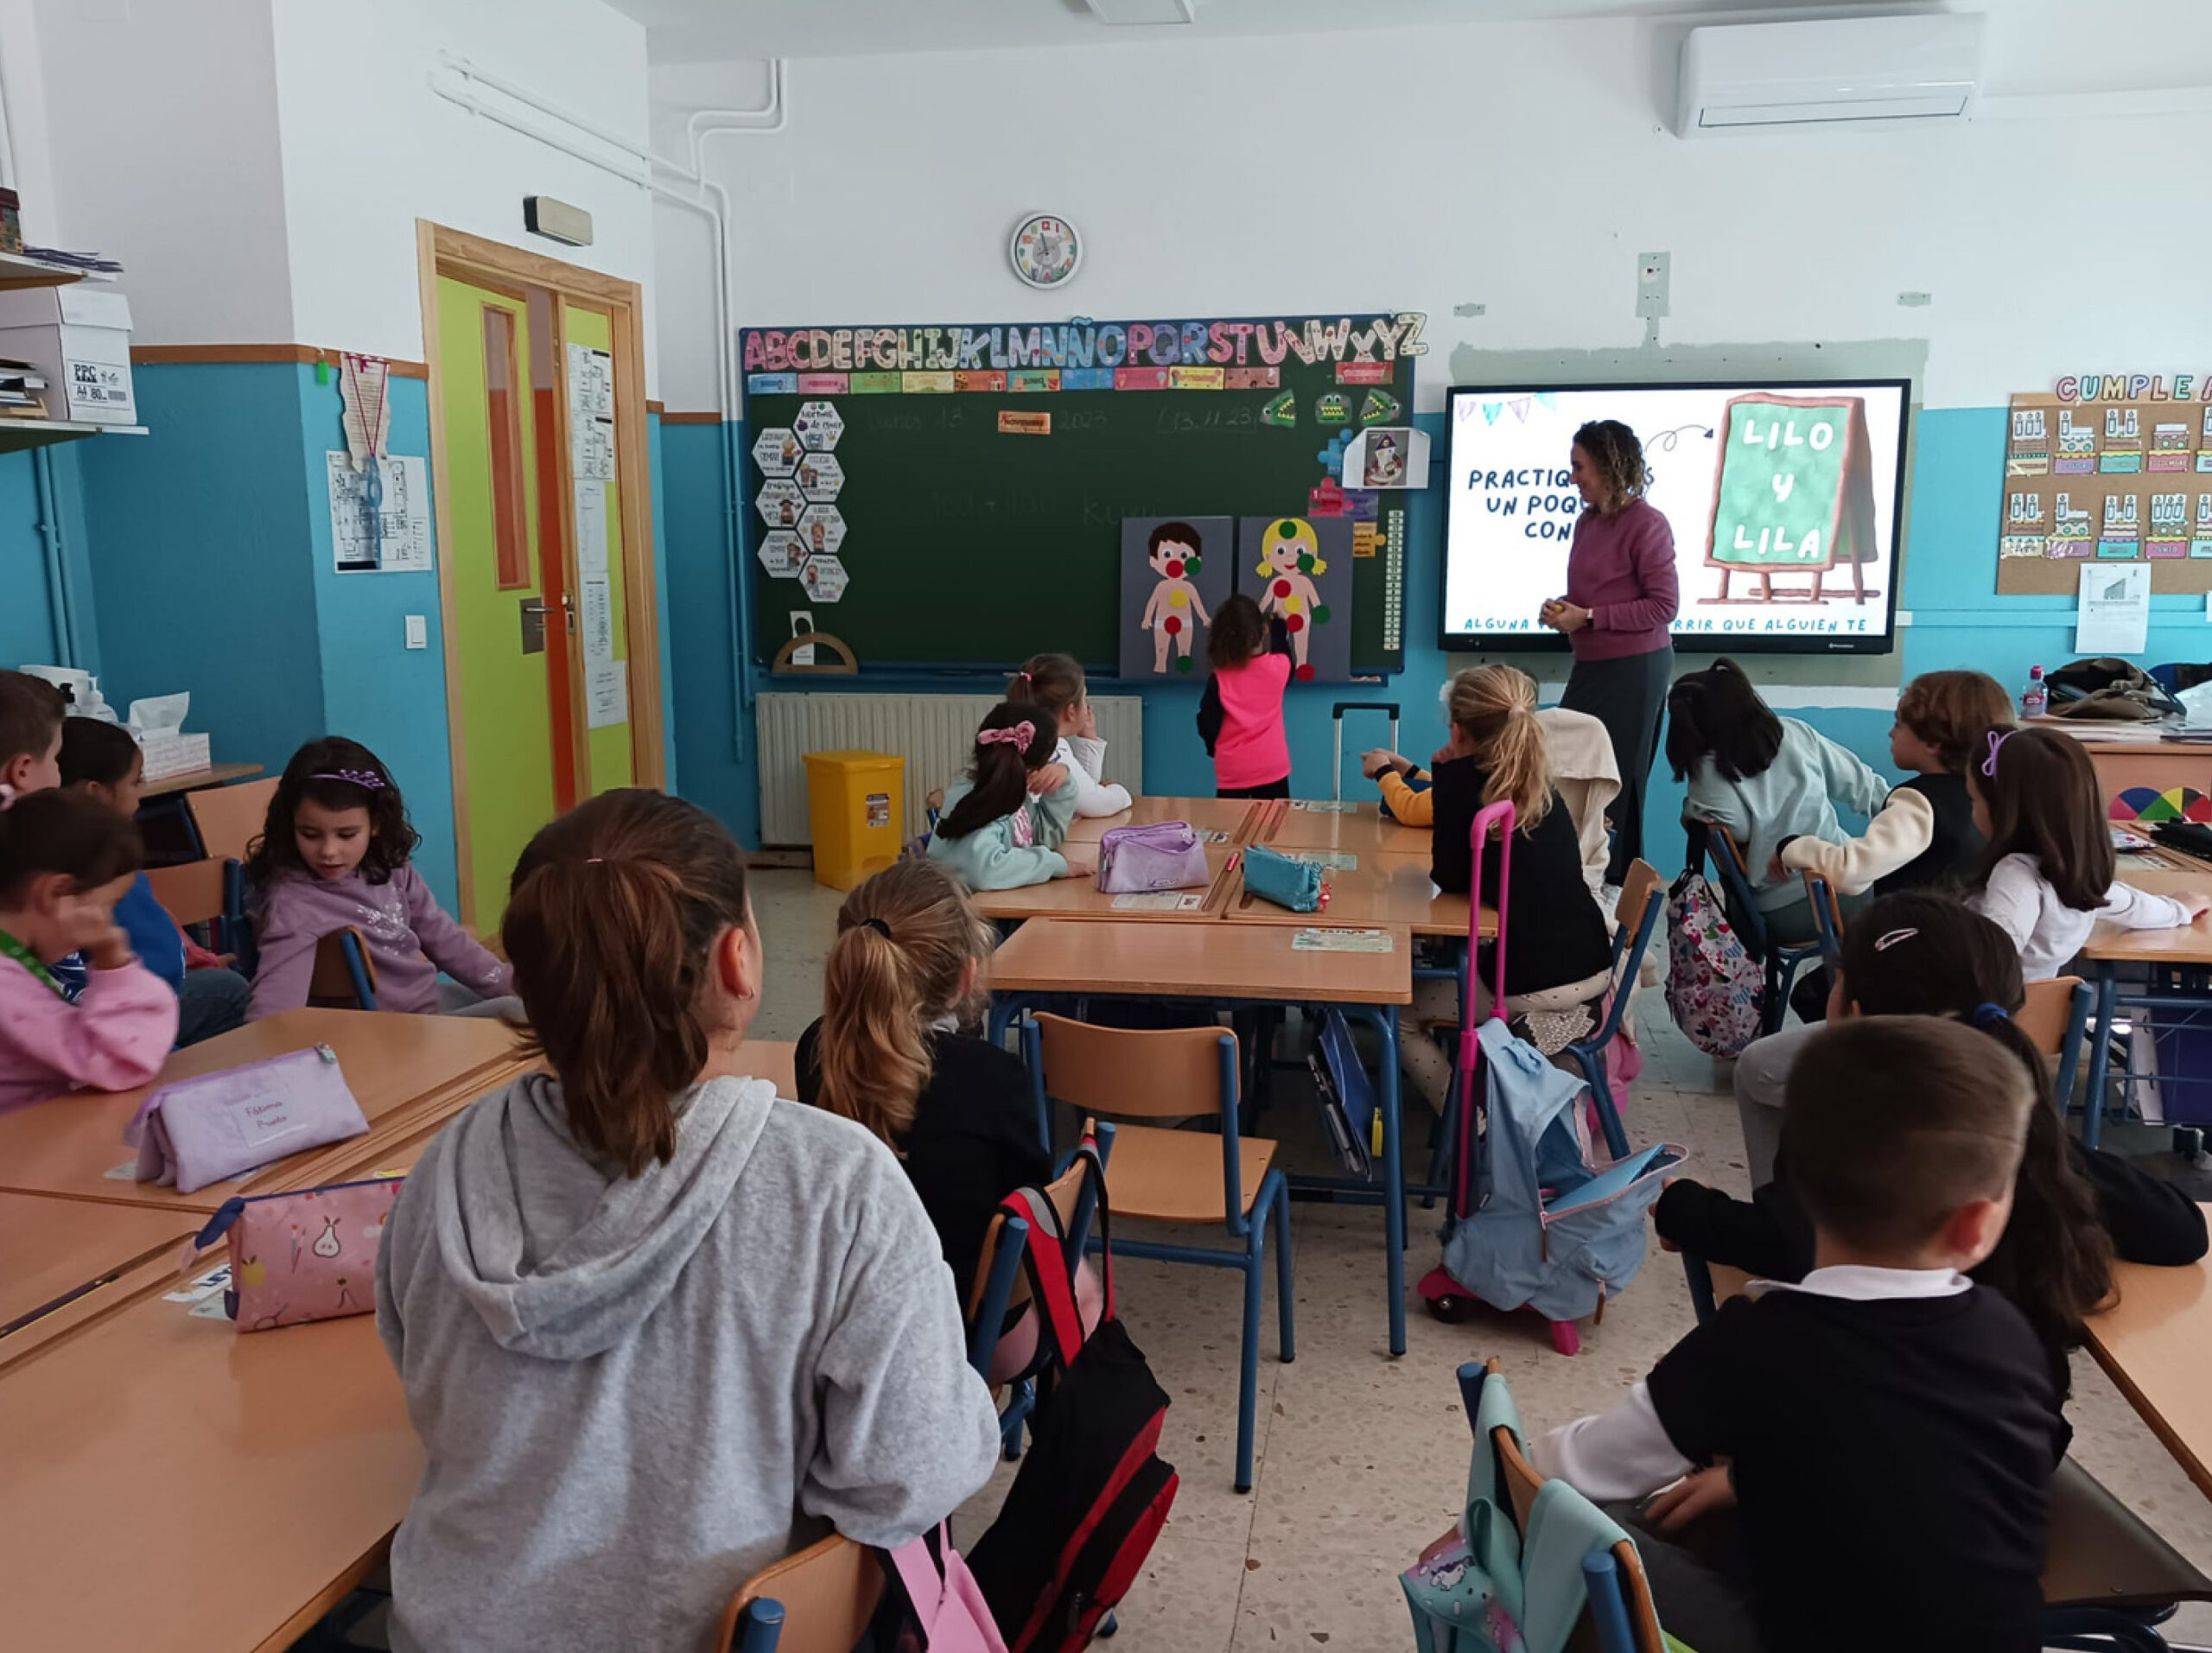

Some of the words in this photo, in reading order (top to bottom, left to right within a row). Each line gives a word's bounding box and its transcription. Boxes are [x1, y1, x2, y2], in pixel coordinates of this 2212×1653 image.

[74, 364, 97, 383] PPC
[1743, 419, 1834, 450] LILO
[1486, 496, 1517, 516] UN
[1524, 520, 1572, 542] CON
[1733, 525, 1820, 559] LILA
[1464, 618, 1529, 630] ALGUNA
[1674, 619, 1713, 631] RRIR
[1723, 618, 1756, 631] QUE
[1764, 619, 1838, 632] ALGUIEN
[1847, 619, 1866, 631] TE
